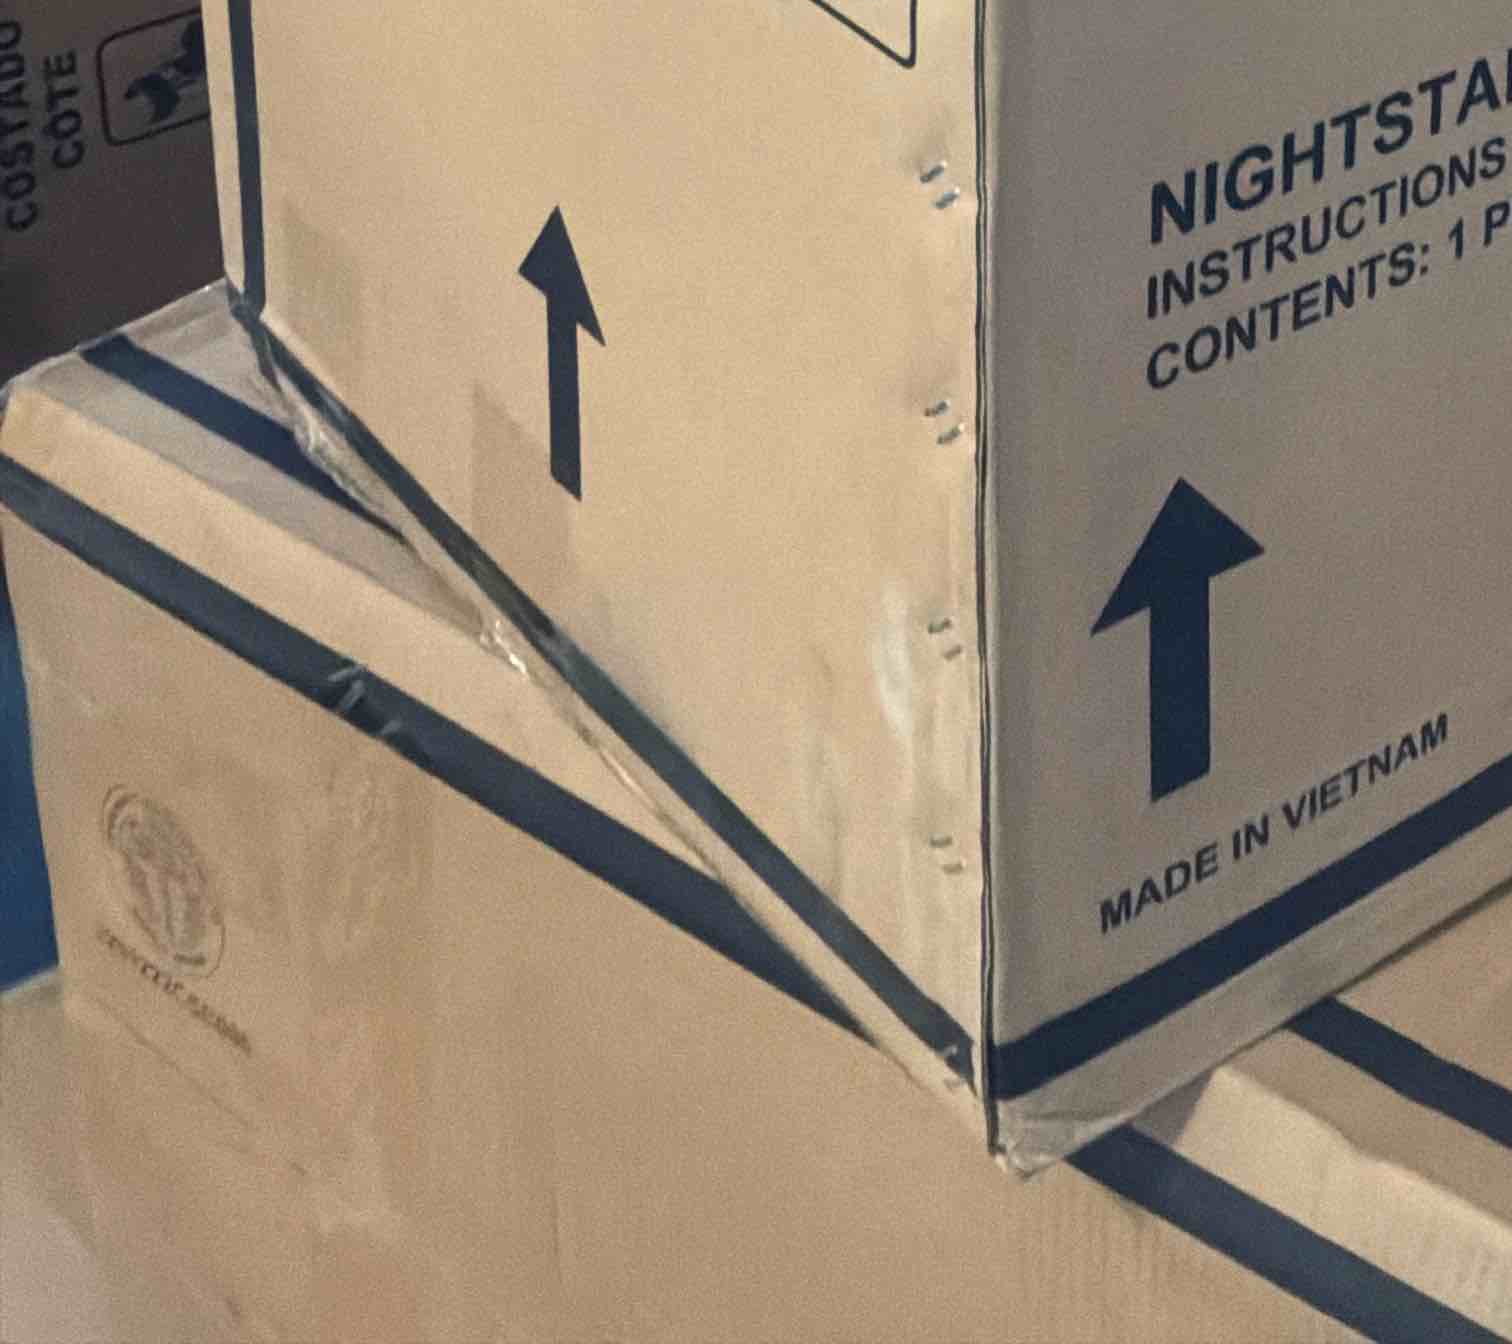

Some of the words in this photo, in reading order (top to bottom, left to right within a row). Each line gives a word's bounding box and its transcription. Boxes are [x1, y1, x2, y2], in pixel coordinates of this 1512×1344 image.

[1145, 135, 1507, 319] INSTRUCTIONS
[1145, 240, 1431, 390] CONTENTS:
[1448, 217, 1465, 261] 1
[1100, 840, 1219, 935] MADE
[1231, 814, 1270, 861] IN
[1281, 712, 1449, 831] VIETNAM
